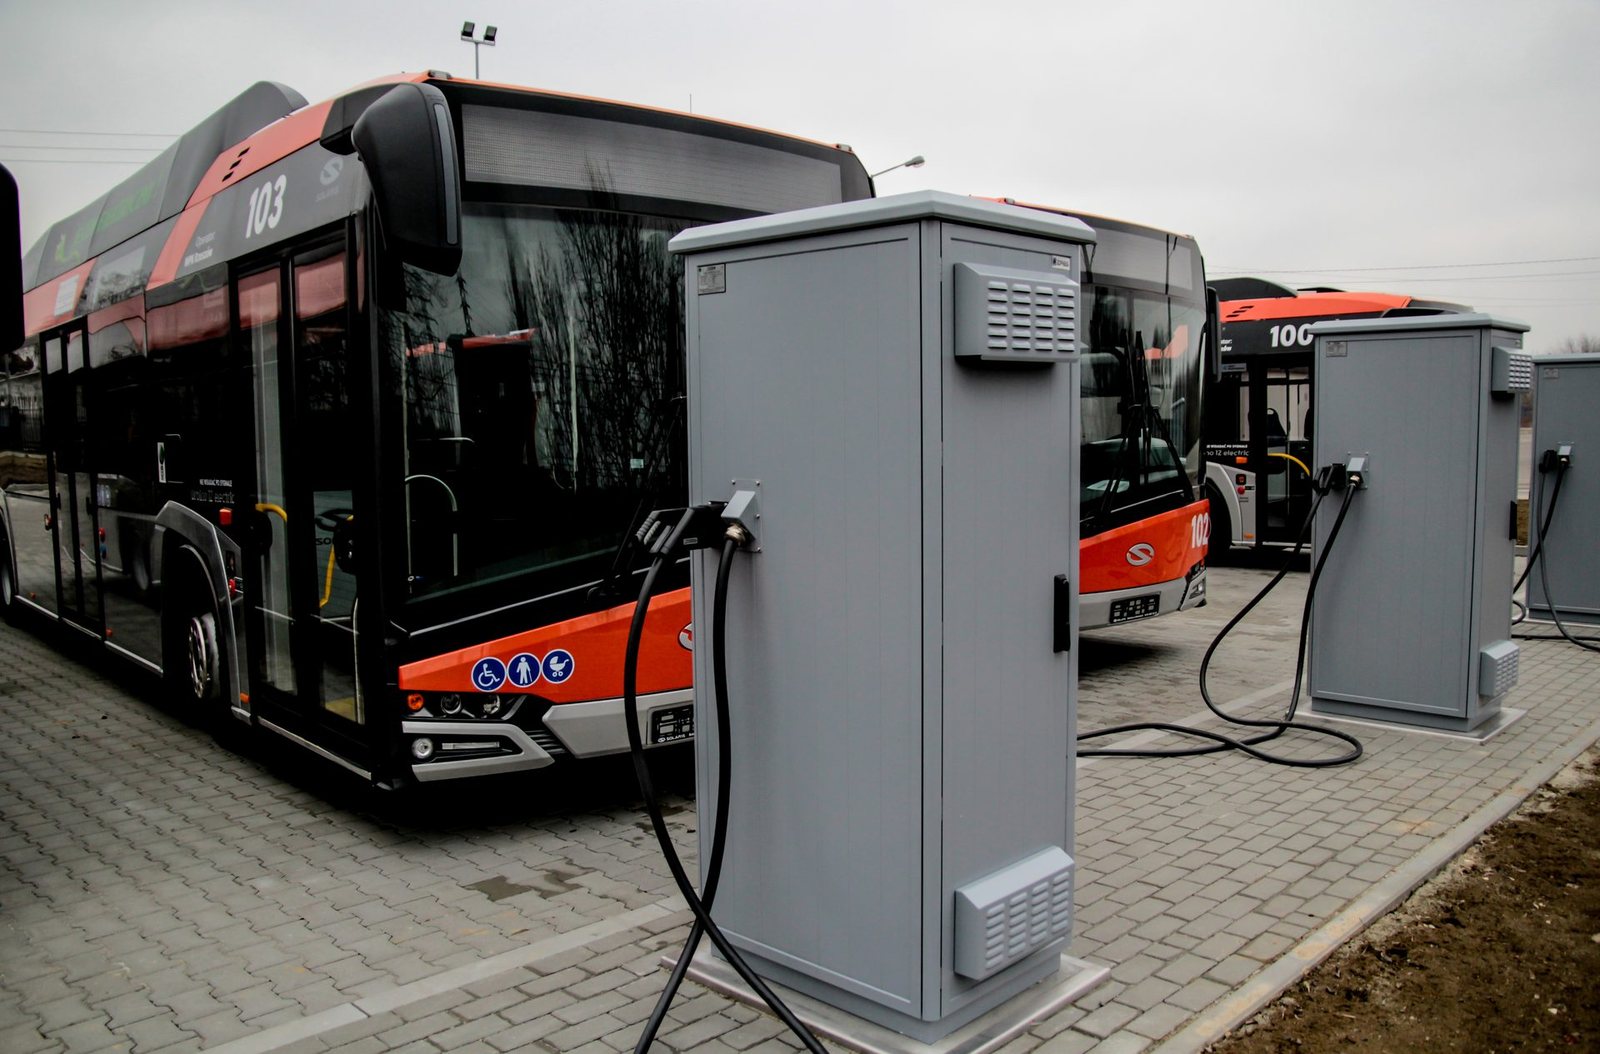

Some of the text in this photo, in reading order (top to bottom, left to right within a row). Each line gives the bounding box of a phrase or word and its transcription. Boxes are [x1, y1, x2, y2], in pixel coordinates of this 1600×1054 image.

[245, 174, 287, 239] 103
[1270, 323, 1314, 348] 100
[1191, 512, 1209, 549] 102
